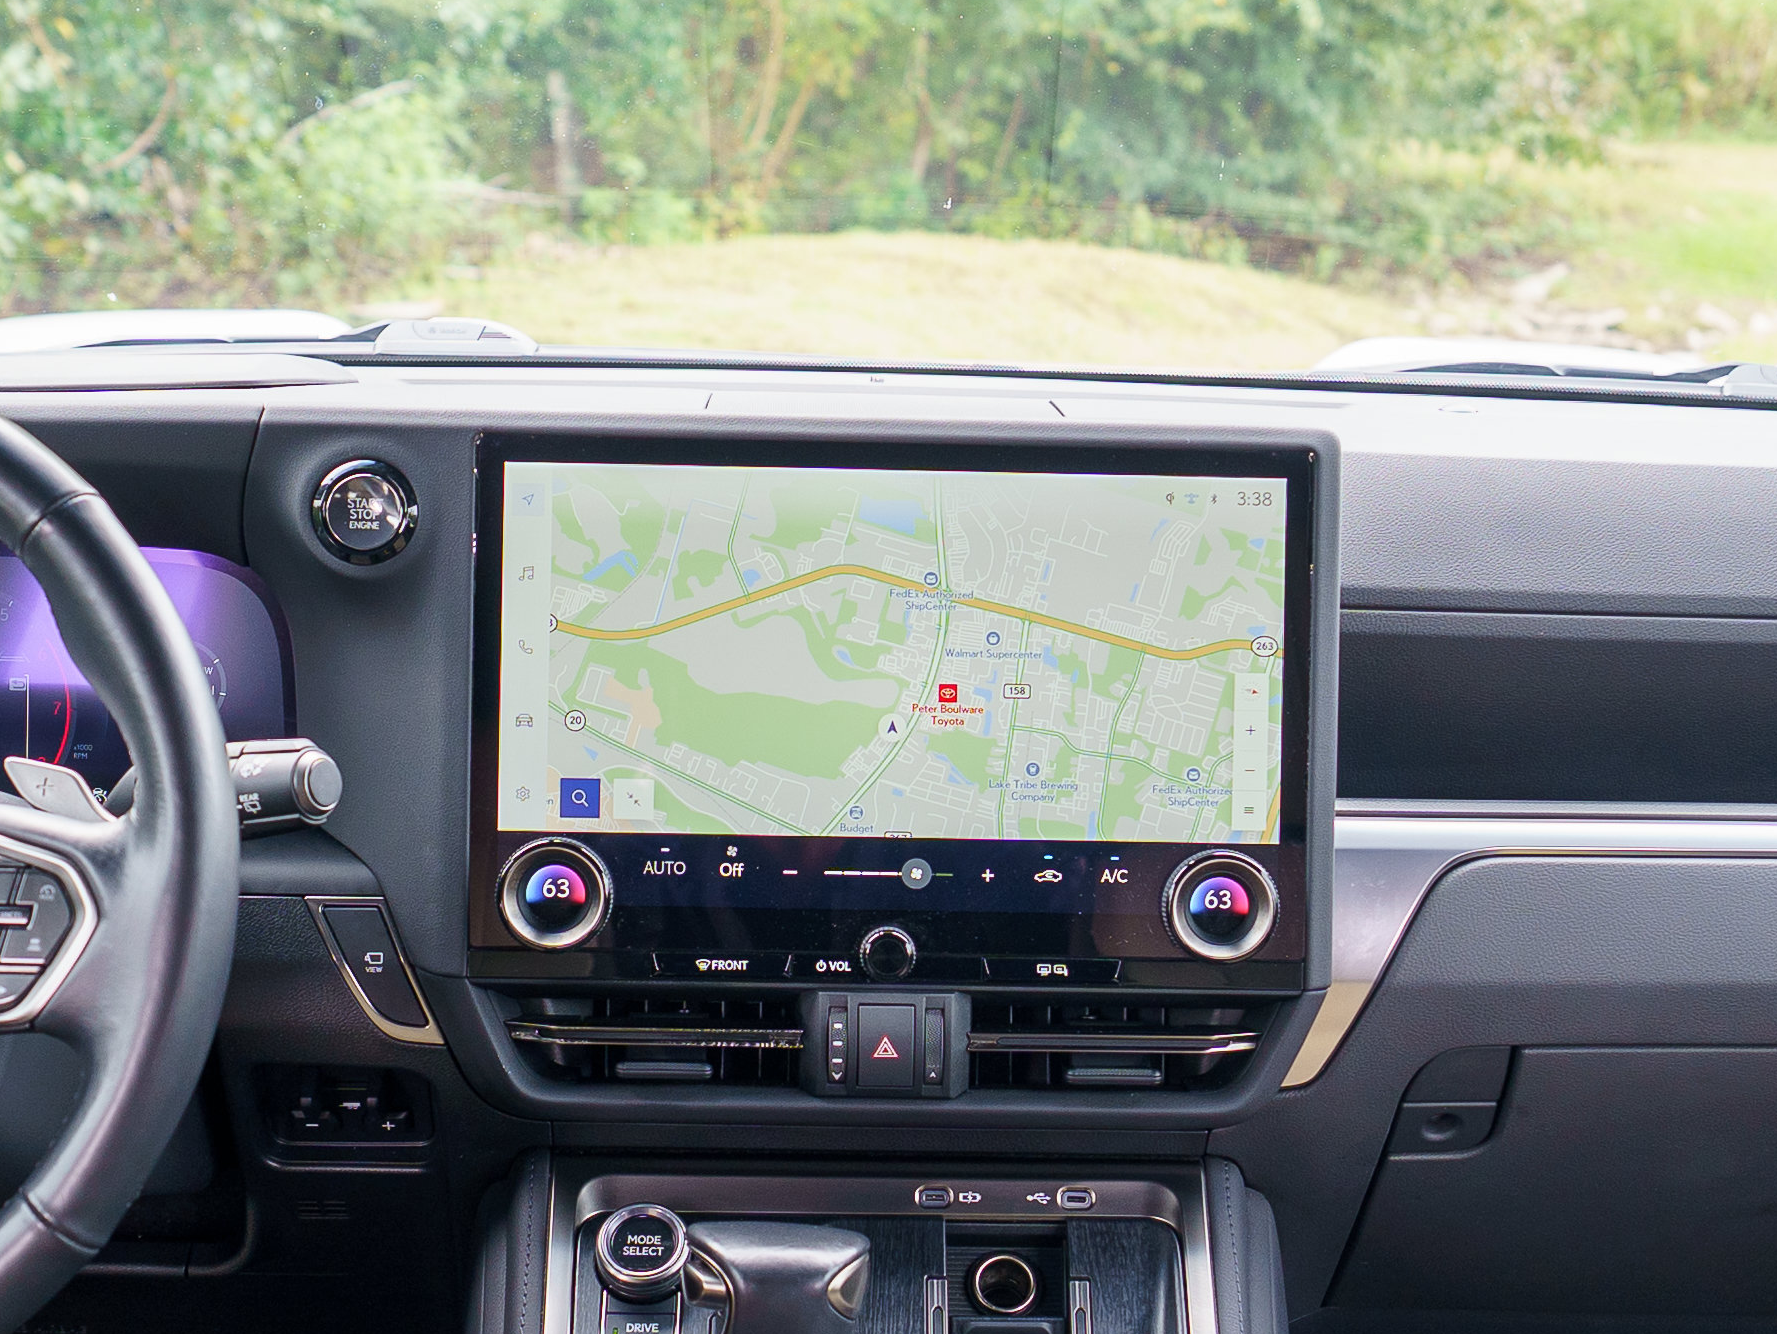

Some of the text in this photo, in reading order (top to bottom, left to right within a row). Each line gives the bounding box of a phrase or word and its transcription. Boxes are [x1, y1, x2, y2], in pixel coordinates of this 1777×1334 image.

[347, 498, 384, 509] START
[1237, 491, 1273, 507] 3:38
[350, 509, 378, 519] STOP
[349, 521, 380, 530] ENGINE
[889, 588, 974, 599] FedEx Authorized
[905, 601, 957, 611] ShipCenter
[0, 608, 9, 621] 5
[1256, 641, 1274, 651] 263
[945, 649, 1043, 660] Walmart Supercenter
[1009, 687, 1026, 695] 158
[912, 703, 984, 714] Peter Boulware
[569, 716, 582, 725] 20
[931, 716, 965, 727] Toyota
[989, 779, 1078, 792] Lake Tribe Brewing
[1153, 785, 1182, 795] FedEx
[239, 793, 260, 801] REAR
[1011, 792, 1055, 802] Company
[1168, 796, 1219, 807] ShipCenter
[839, 822, 874, 834] Budget
[643, 861, 686, 875] AUTO
[720, 862, 744, 878] Off
[1101, 869, 1129, 884] A/C
[542, 878, 570, 898] 63
[1205, 889, 1232, 909] 63
[712, 960, 748, 971] FRONT
[829, 961, 852, 972] VOL
[627, 1235, 662, 1245] MODE
[623, 1246, 664, 1256] SELECT
[626, 1323, 659, 1333] DRIVE
